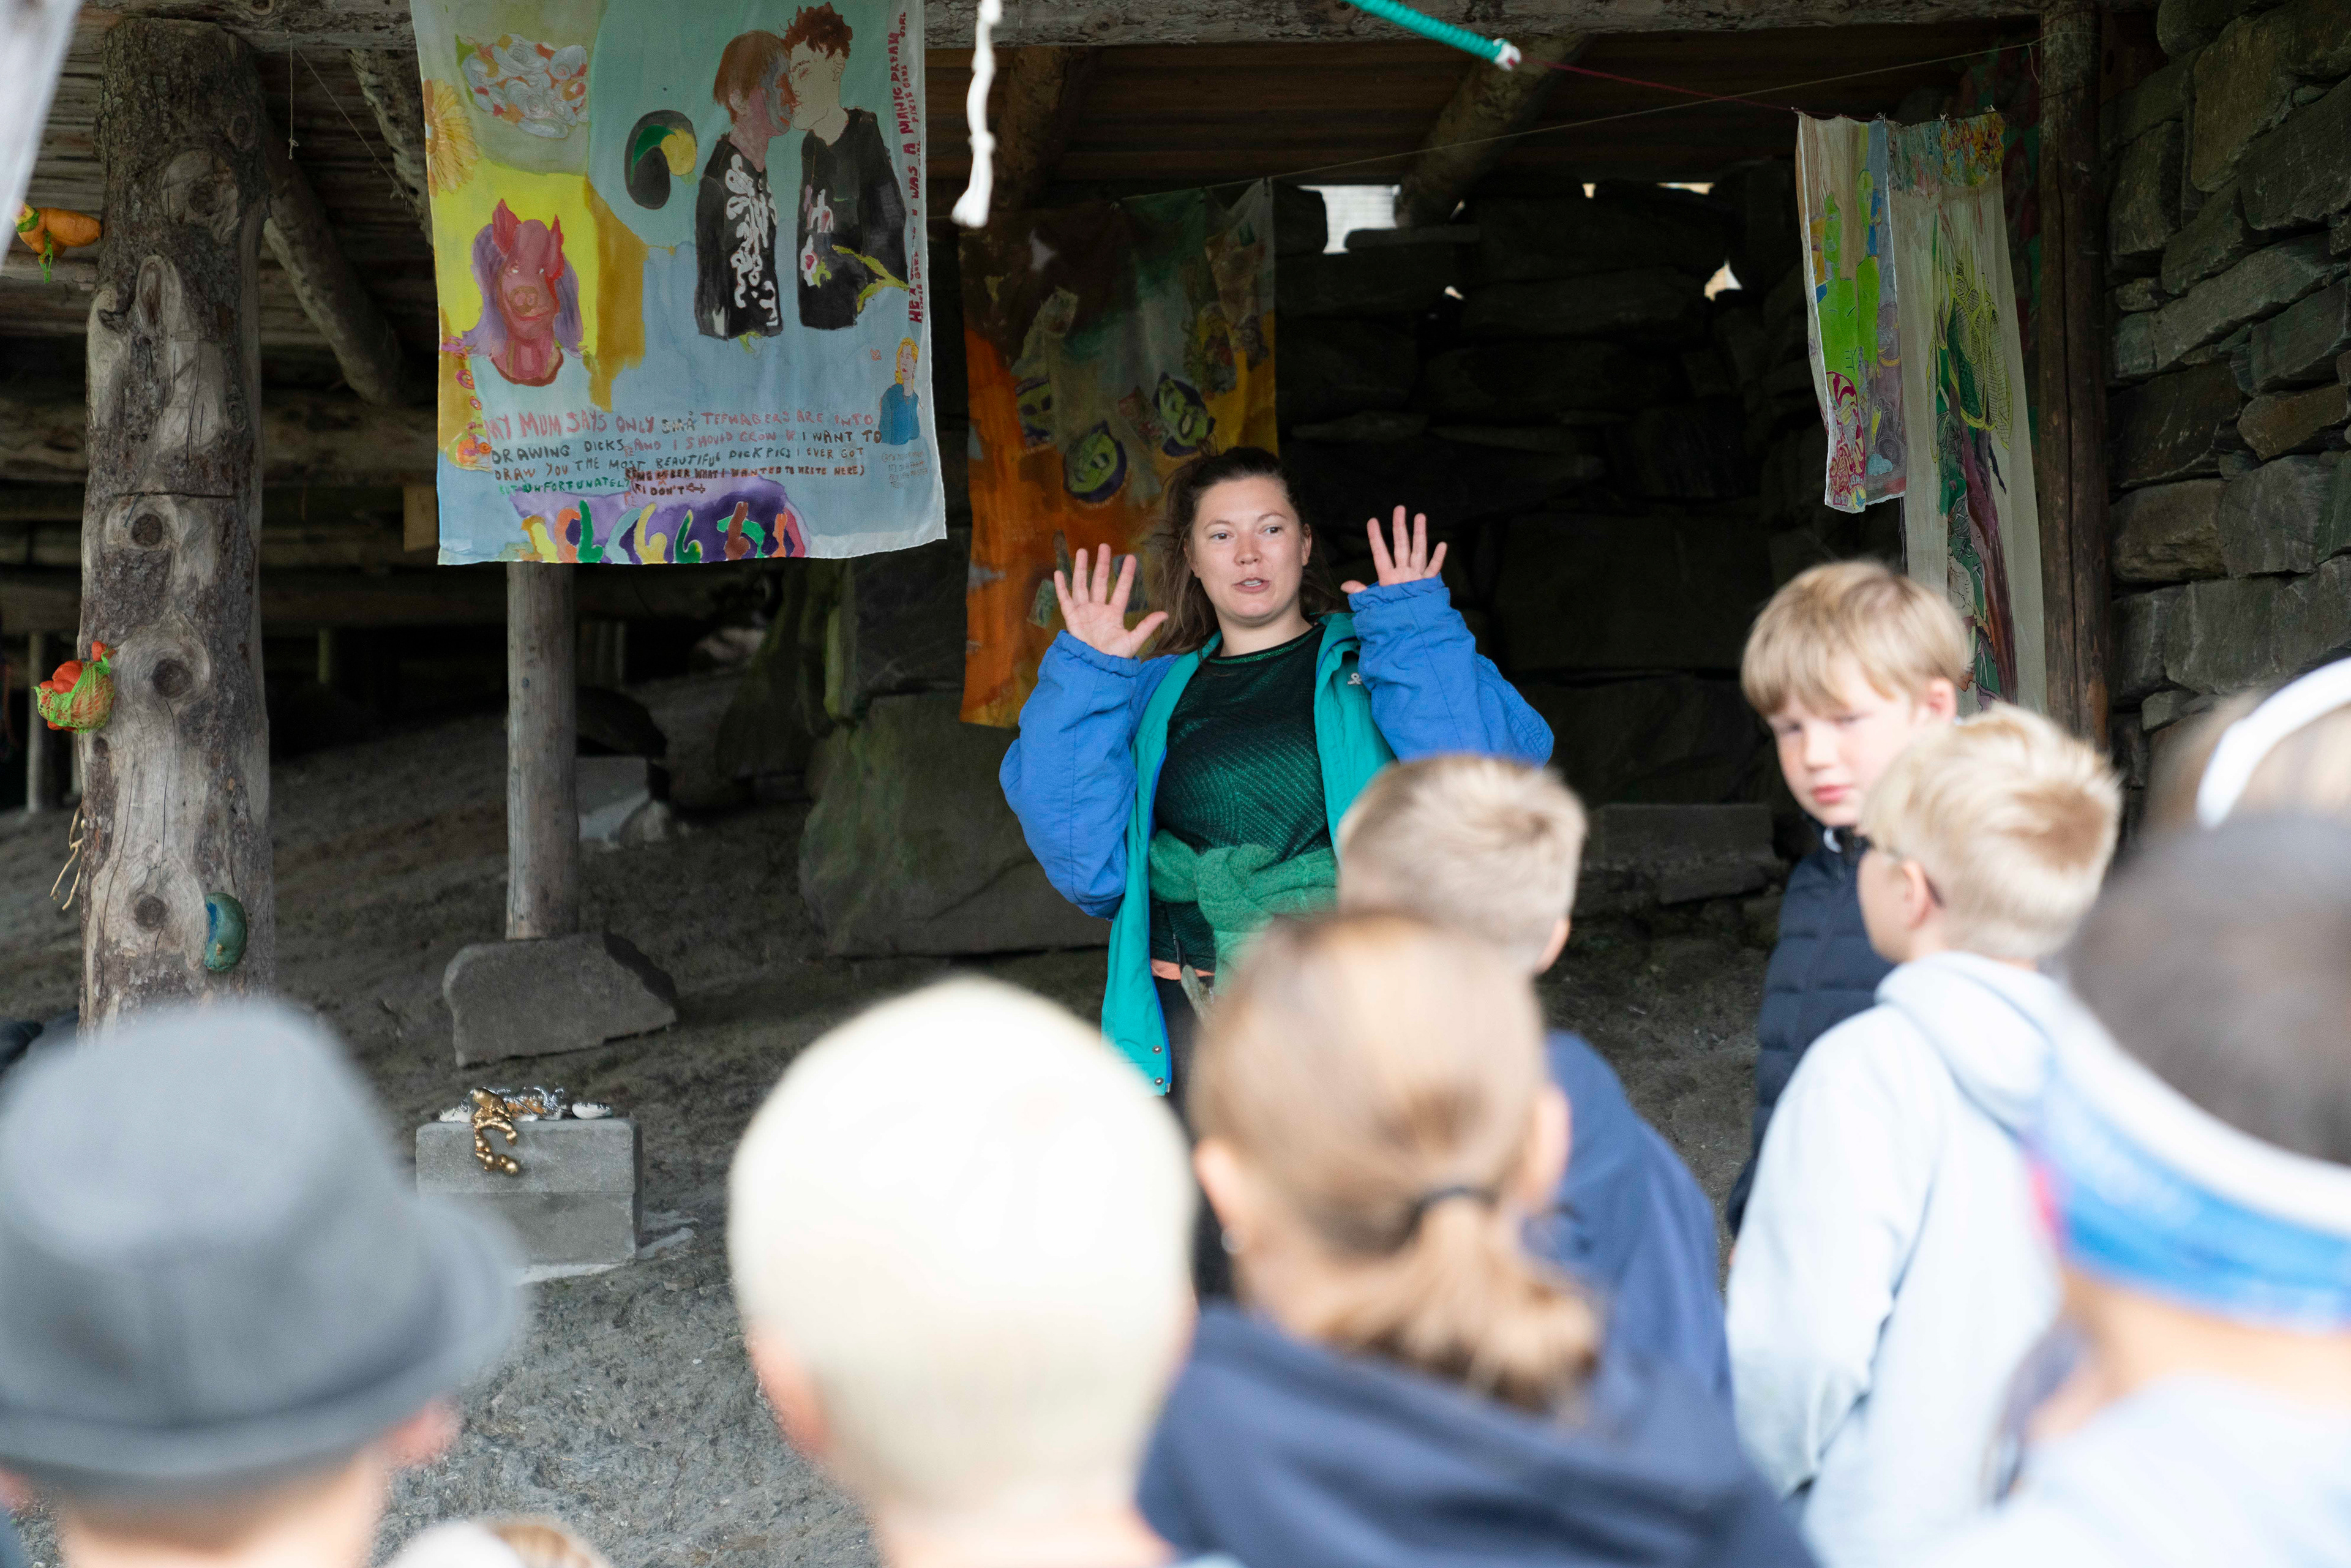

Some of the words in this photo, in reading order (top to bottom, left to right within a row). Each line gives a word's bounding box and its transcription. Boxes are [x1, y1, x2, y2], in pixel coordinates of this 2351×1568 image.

[888, 32, 901, 82] DREAM
[892, 86, 915, 134] MANIC
[902, 143, 917, 156] A
[907, 165, 919, 199] WAS
[908, 300, 922, 323] HE
[484, 413, 511, 445] MY
[518, 411, 562, 437] MUM
[566, 408, 608, 433] SAYS
[615, 415, 654, 434] ONLY
[797, 409, 823, 423] ARE
[834, 413, 874, 426] INTO
[491, 444, 571, 464] DRAWING
[583, 438, 624, 453] DICKS
[634, 437, 661, 452] AND
[673, 439, 678, 451] I
[739, 430, 776, 442] GROW
[802, 431, 806, 441] I
[812, 430, 853, 444] WANT
[861, 429, 882, 444] TO
[495, 468, 536, 483] DRAW
[545, 462, 569, 477] YOU
[574, 457, 600, 471] THE
[609, 459, 647, 472] MOST
[656, 451, 721, 469] BEAUTIFUL
[806, 447, 833, 459] EVER
[841, 447, 864, 459] GOT
[694, 468, 718, 479] WHAT
[721, 468, 726, 479] I
[730, 466, 782, 478] WANTED
[797, 465, 827, 476] WRITE
